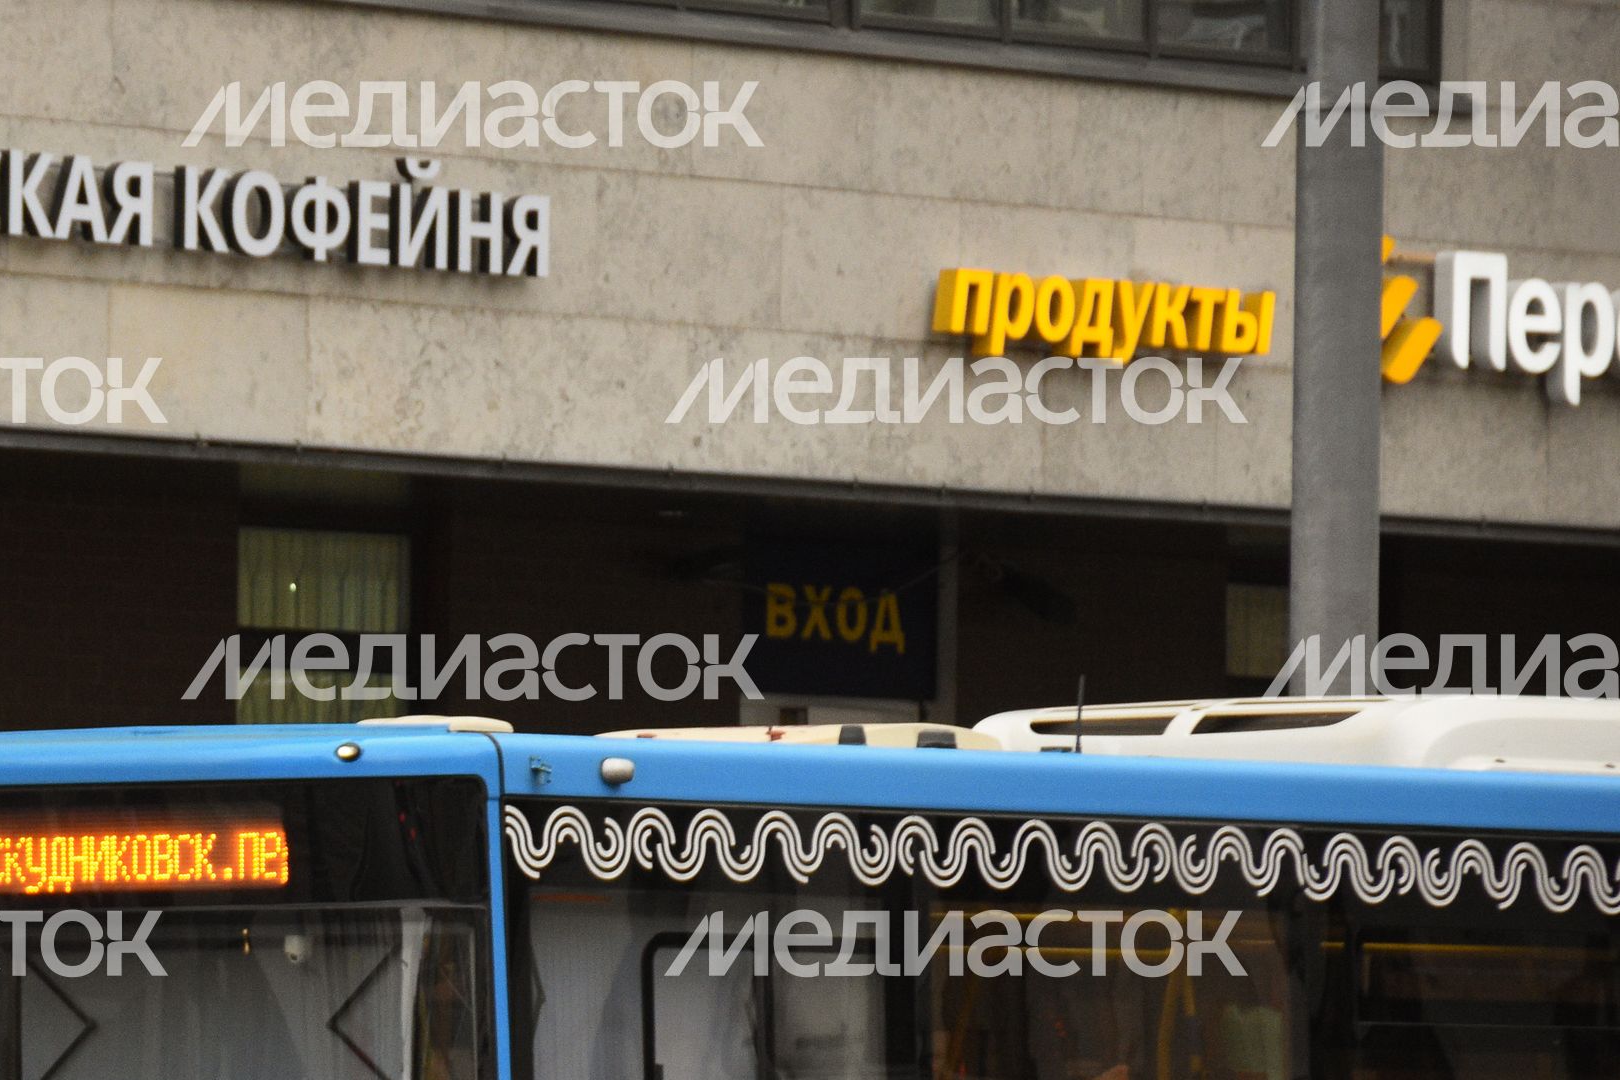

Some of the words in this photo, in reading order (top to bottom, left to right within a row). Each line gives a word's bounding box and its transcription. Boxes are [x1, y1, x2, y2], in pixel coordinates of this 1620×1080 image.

[183, 158, 551, 278] КОФЕЙНЯ
[1440, 250, 1620, 406] Пер
[765, 583, 906, 654] ВХОД
